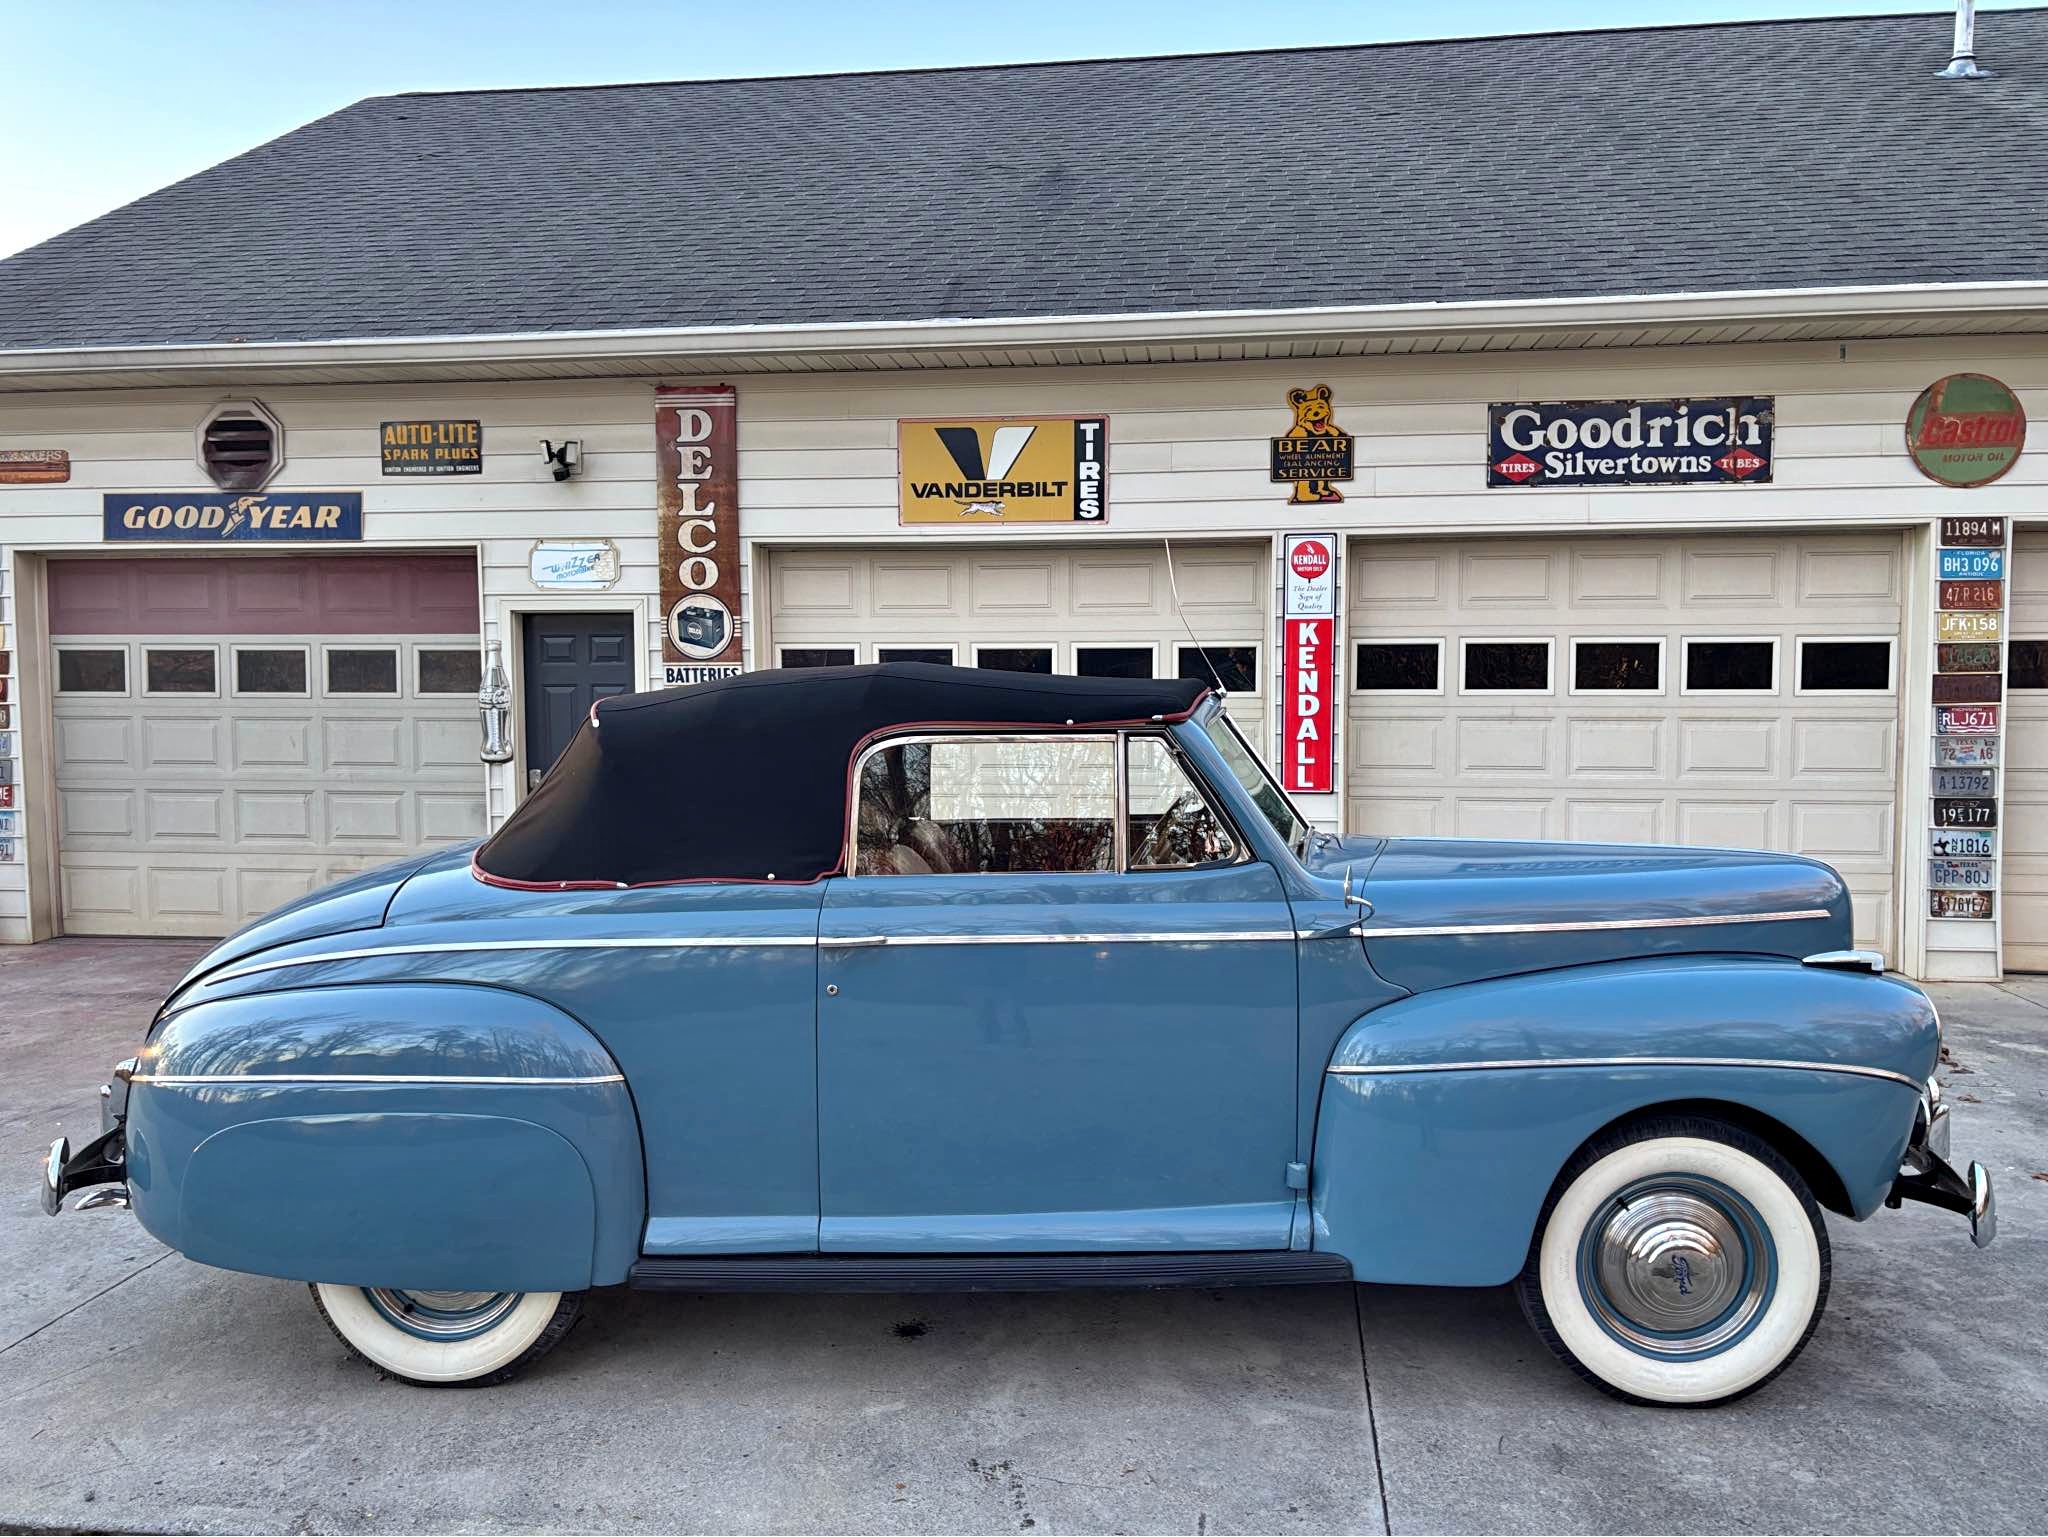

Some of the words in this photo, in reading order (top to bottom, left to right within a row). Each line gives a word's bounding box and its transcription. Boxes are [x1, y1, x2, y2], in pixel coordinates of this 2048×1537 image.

[384, 423, 478, 445] AUTO-LITE
[1500, 405, 1762, 452] Goodrich
[384, 448, 429, 460] SPARK
[435, 447, 479, 460] PLUGS
[1278, 440, 1347, 452] BEAR
[1544, 451, 1712, 479] Silvertowns
[1942, 453, 1984, 463] MOTOR
[1987, 452, 2005, 462] OIL
[1079, 422, 1101, 518] TIRES
[1278, 467, 1347, 478] SERVICE
[1501, 462, 1536, 474] TIRES
[911, 481, 1068, 498] VANDERBILT
[675, 408, 720, 590] DELCO
[1946, 521, 1987, 536] 11894
[1992, 521, 2001, 536] M
[1293, 554, 1327, 565] KENDALL
[1943, 557, 1969, 572] BH3
[1973, 557, 1999, 572] 096
[1297, 602, 1323, 611] Quality
[666, 667, 739, 684] BATTERIES
[1296, 622, 1320, 788] KENDALL
[1942, 712, 1995, 726] RLJ671
[1959, 837, 1990, 853] 1816
